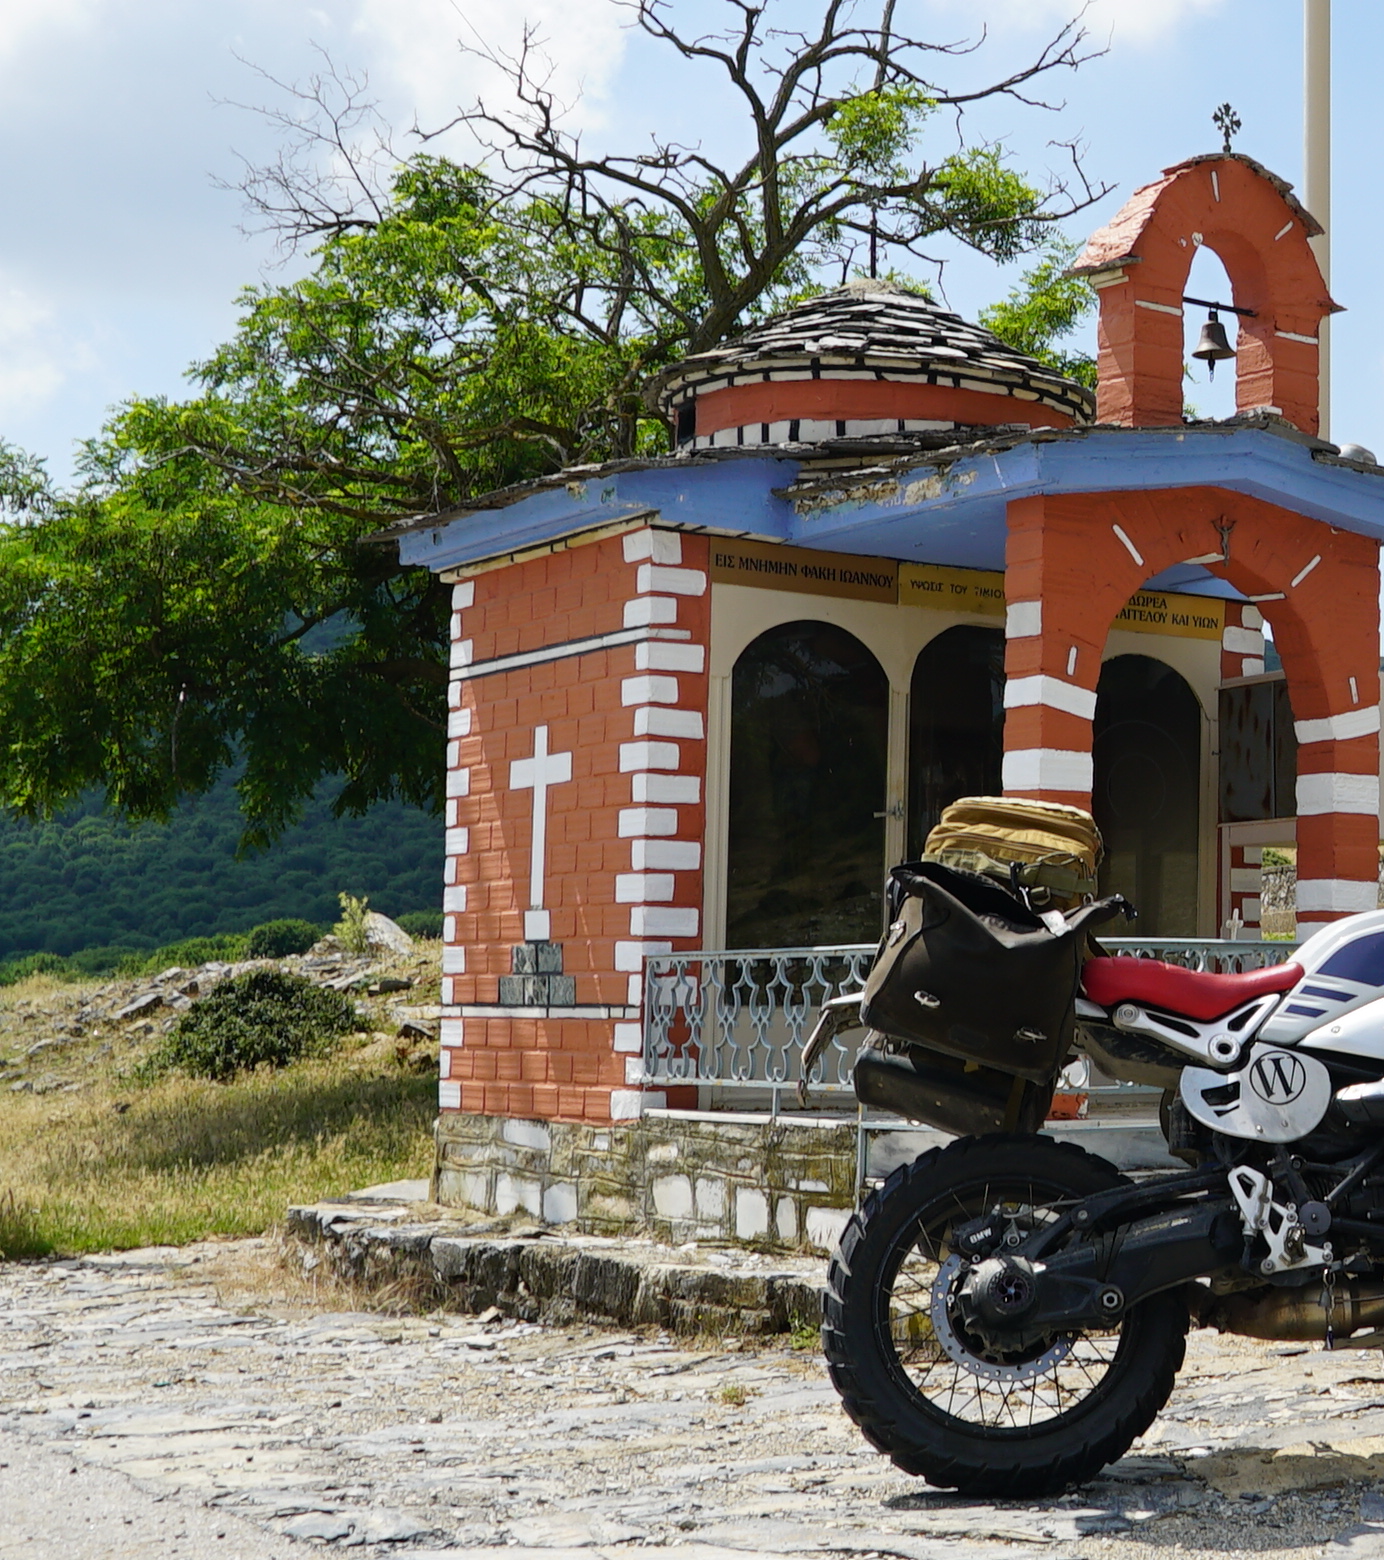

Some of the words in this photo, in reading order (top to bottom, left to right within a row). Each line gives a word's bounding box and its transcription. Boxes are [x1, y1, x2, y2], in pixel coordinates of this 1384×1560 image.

[715, 553, 735, 569] ΕΙΣ
[738, 557, 798, 577] ΜΝΗΜΗΝ
[801, 565, 836, 581] ΦΑΚΗ
[839, 569, 893, 589] ΙΩΑΝΝΟΥ
[950, 584, 967, 595] ΤΟΥ
[1128, 595, 1167, 609] ΔΩΡΕΑ
[1115, 608, 1167, 624] ΑΓΓΕΛΟΥ
[1171, 613, 1190, 627] ΚΑΙ
[1193, 616, 1219, 629] ΥΙΩΝ
[1255, 1055, 1297, 1099] W
